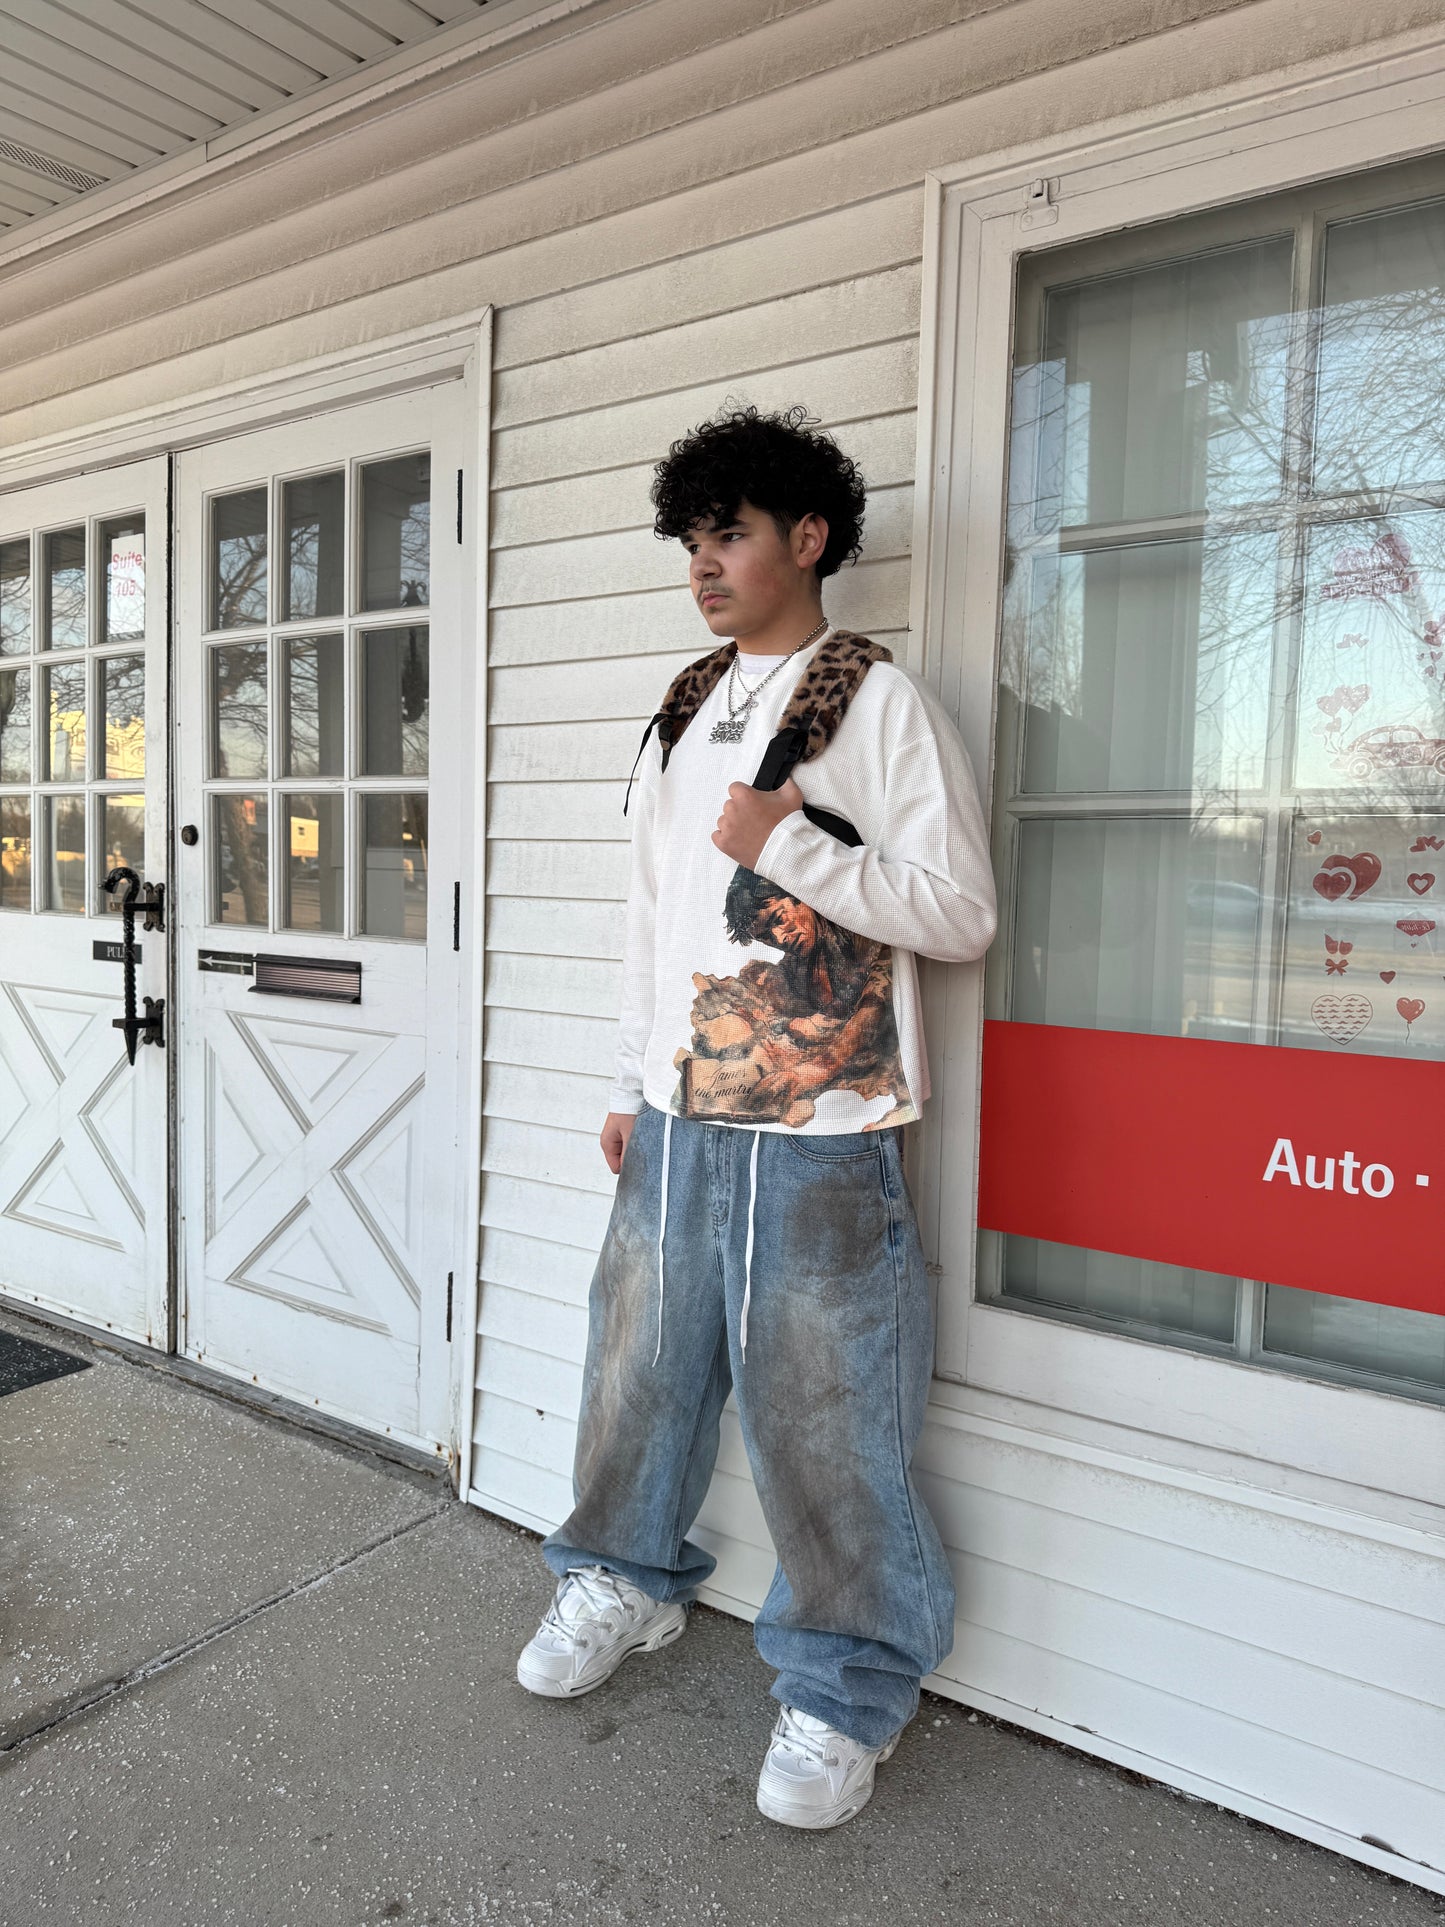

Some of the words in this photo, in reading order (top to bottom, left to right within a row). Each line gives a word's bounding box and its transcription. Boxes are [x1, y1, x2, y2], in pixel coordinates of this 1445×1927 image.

[112, 551, 143, 570] Suite
[116, 579, 136, 597] 105
[695, 1087, 711, 1098] the
[1262, 1138, 1394, 1198] Auto
